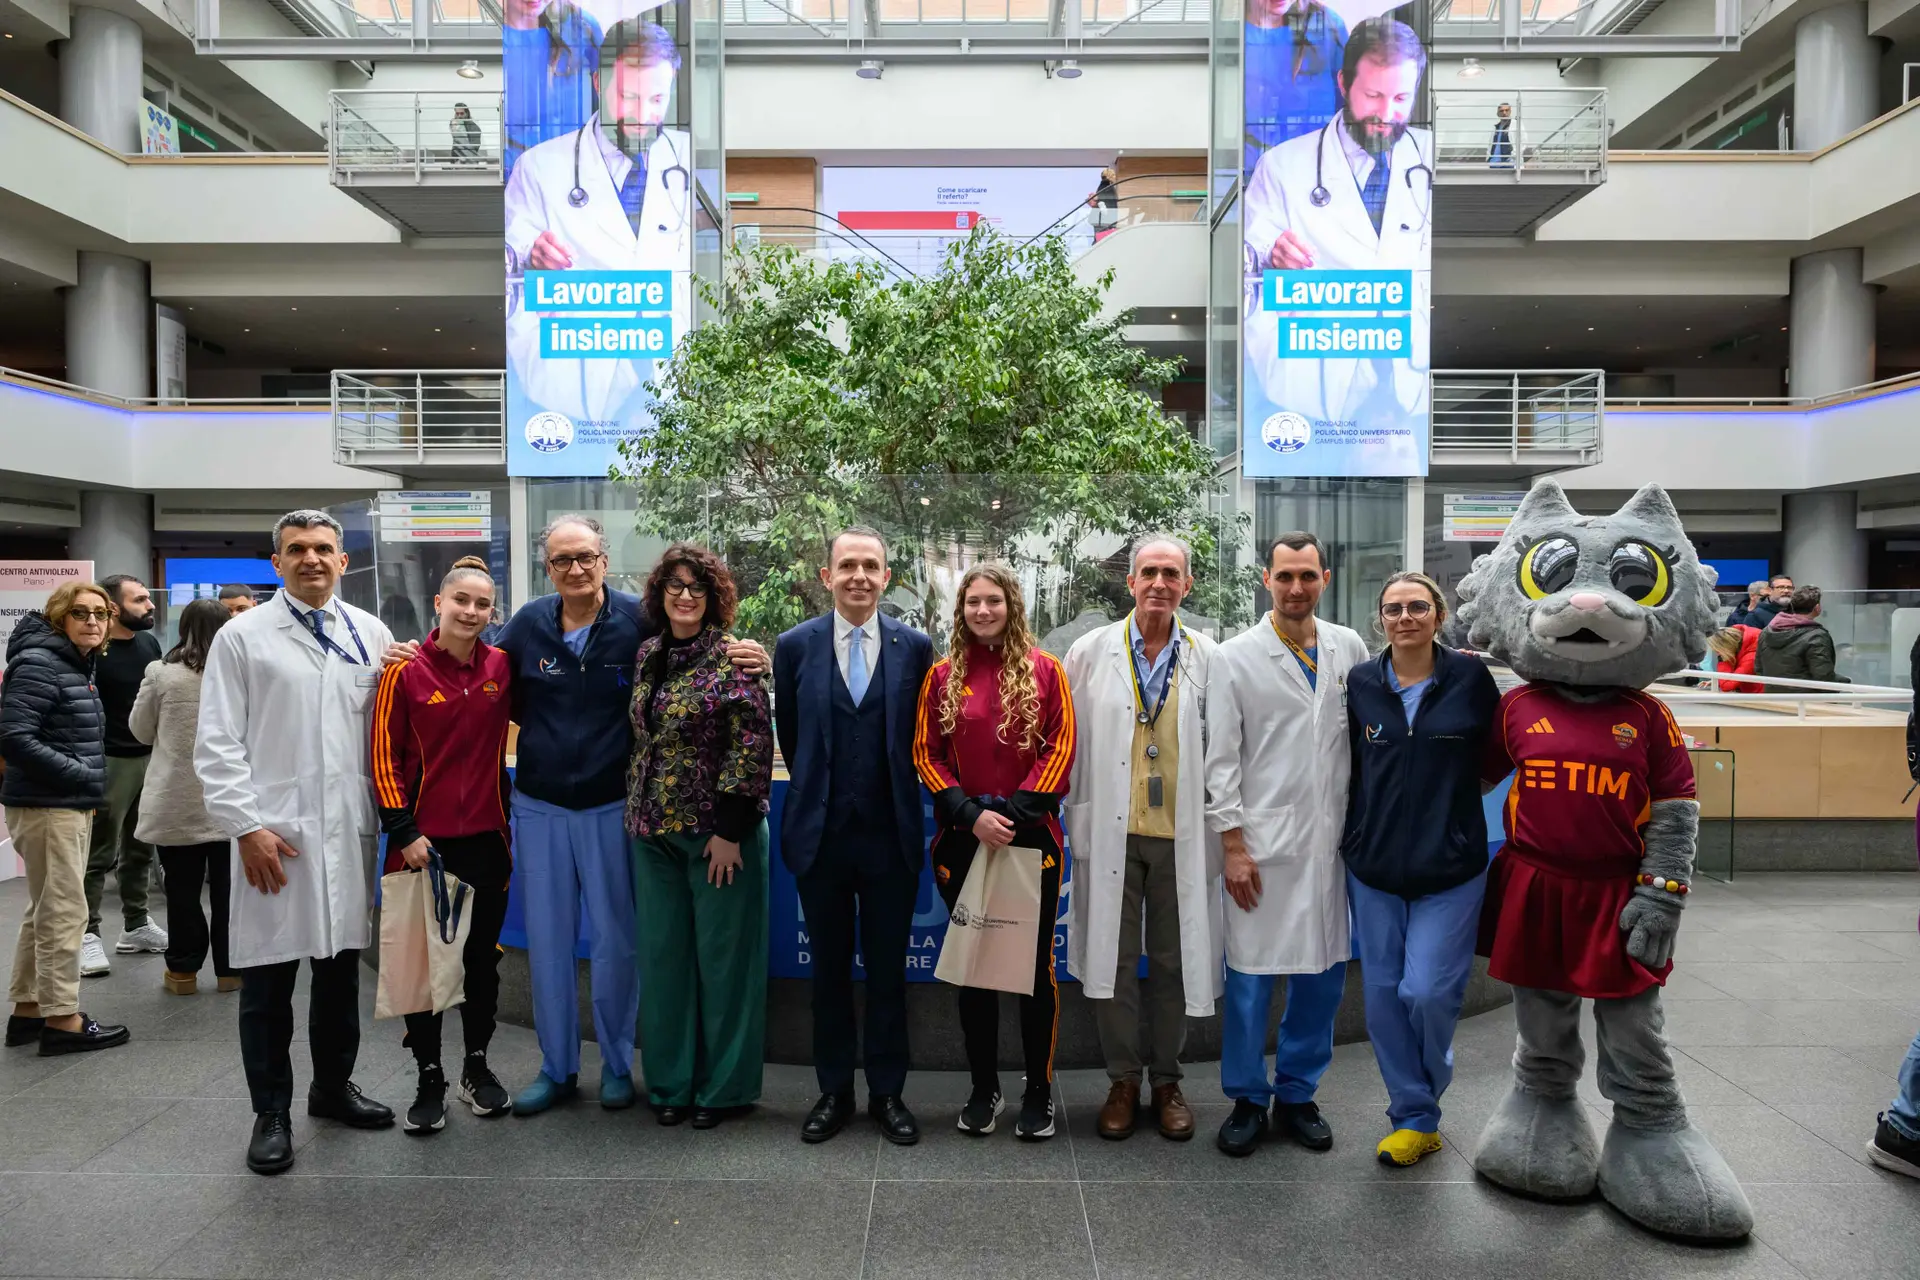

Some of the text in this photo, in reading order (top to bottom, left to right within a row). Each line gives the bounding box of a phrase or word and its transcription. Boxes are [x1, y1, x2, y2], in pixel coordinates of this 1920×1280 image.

[536, 276, 664, 305] Lavorare
[1275, 276, 1404, 304] Lavorare
[551, 322, 664, 351] insieme
[1289, 321, 1403, 351] insieme
[0, 568, 79, 576] CENTRO ANTIVIOLENZA
[23, 578, 55, 586] Piano -1
[1562, 760, 1631, 800] TIM
